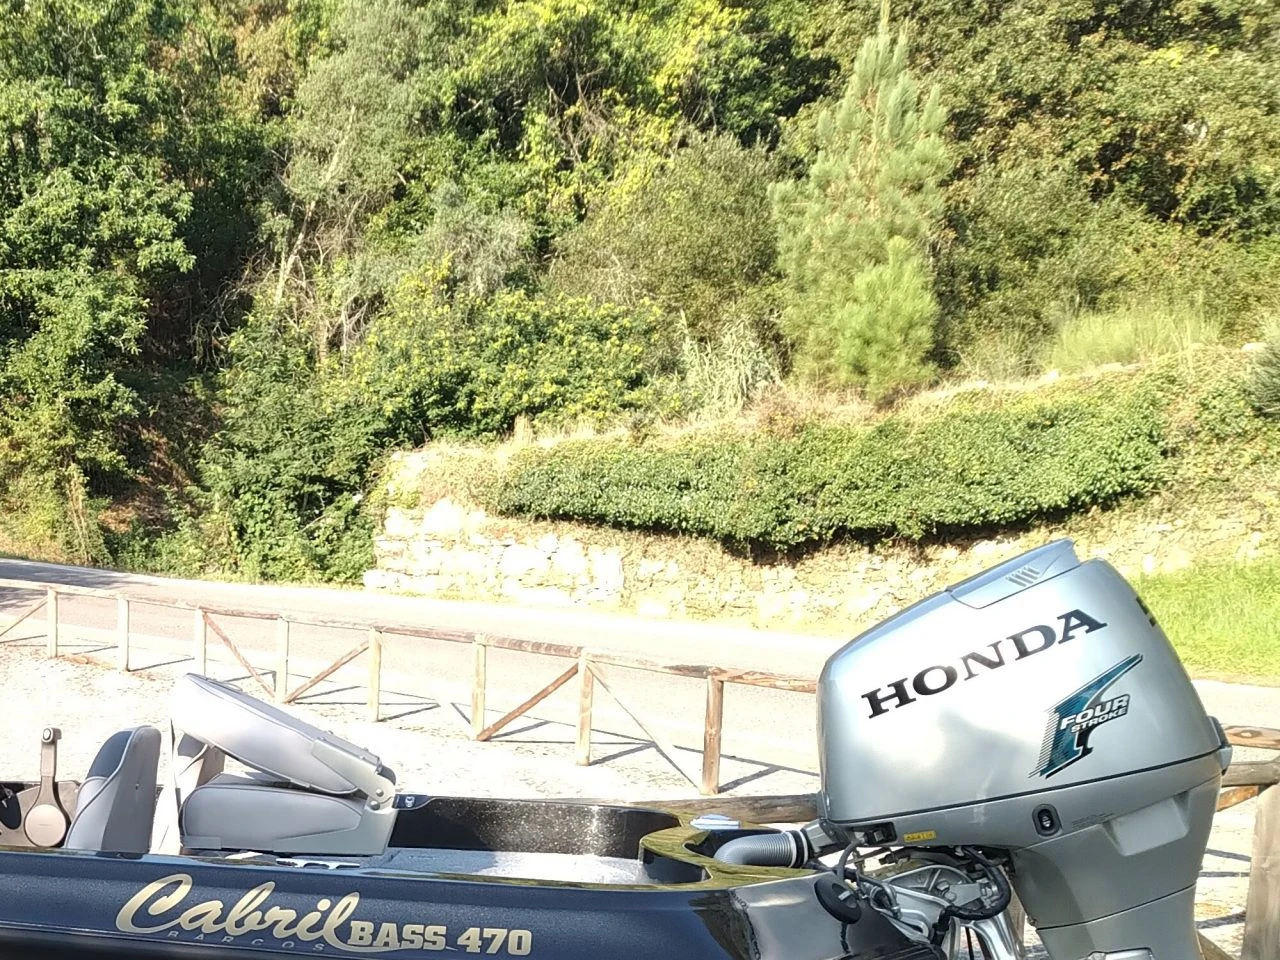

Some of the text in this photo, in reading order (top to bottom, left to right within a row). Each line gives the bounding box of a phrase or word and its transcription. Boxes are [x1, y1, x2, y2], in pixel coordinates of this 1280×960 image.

[861, 608, 1108, 719] HONDA
[1060, 694, 1129, 731] FOUR
[1071, 707, 1127, 734] STROKE
[116, 873, 360, 952] Cabril
[346, 920, 533, 956] BASS 470
